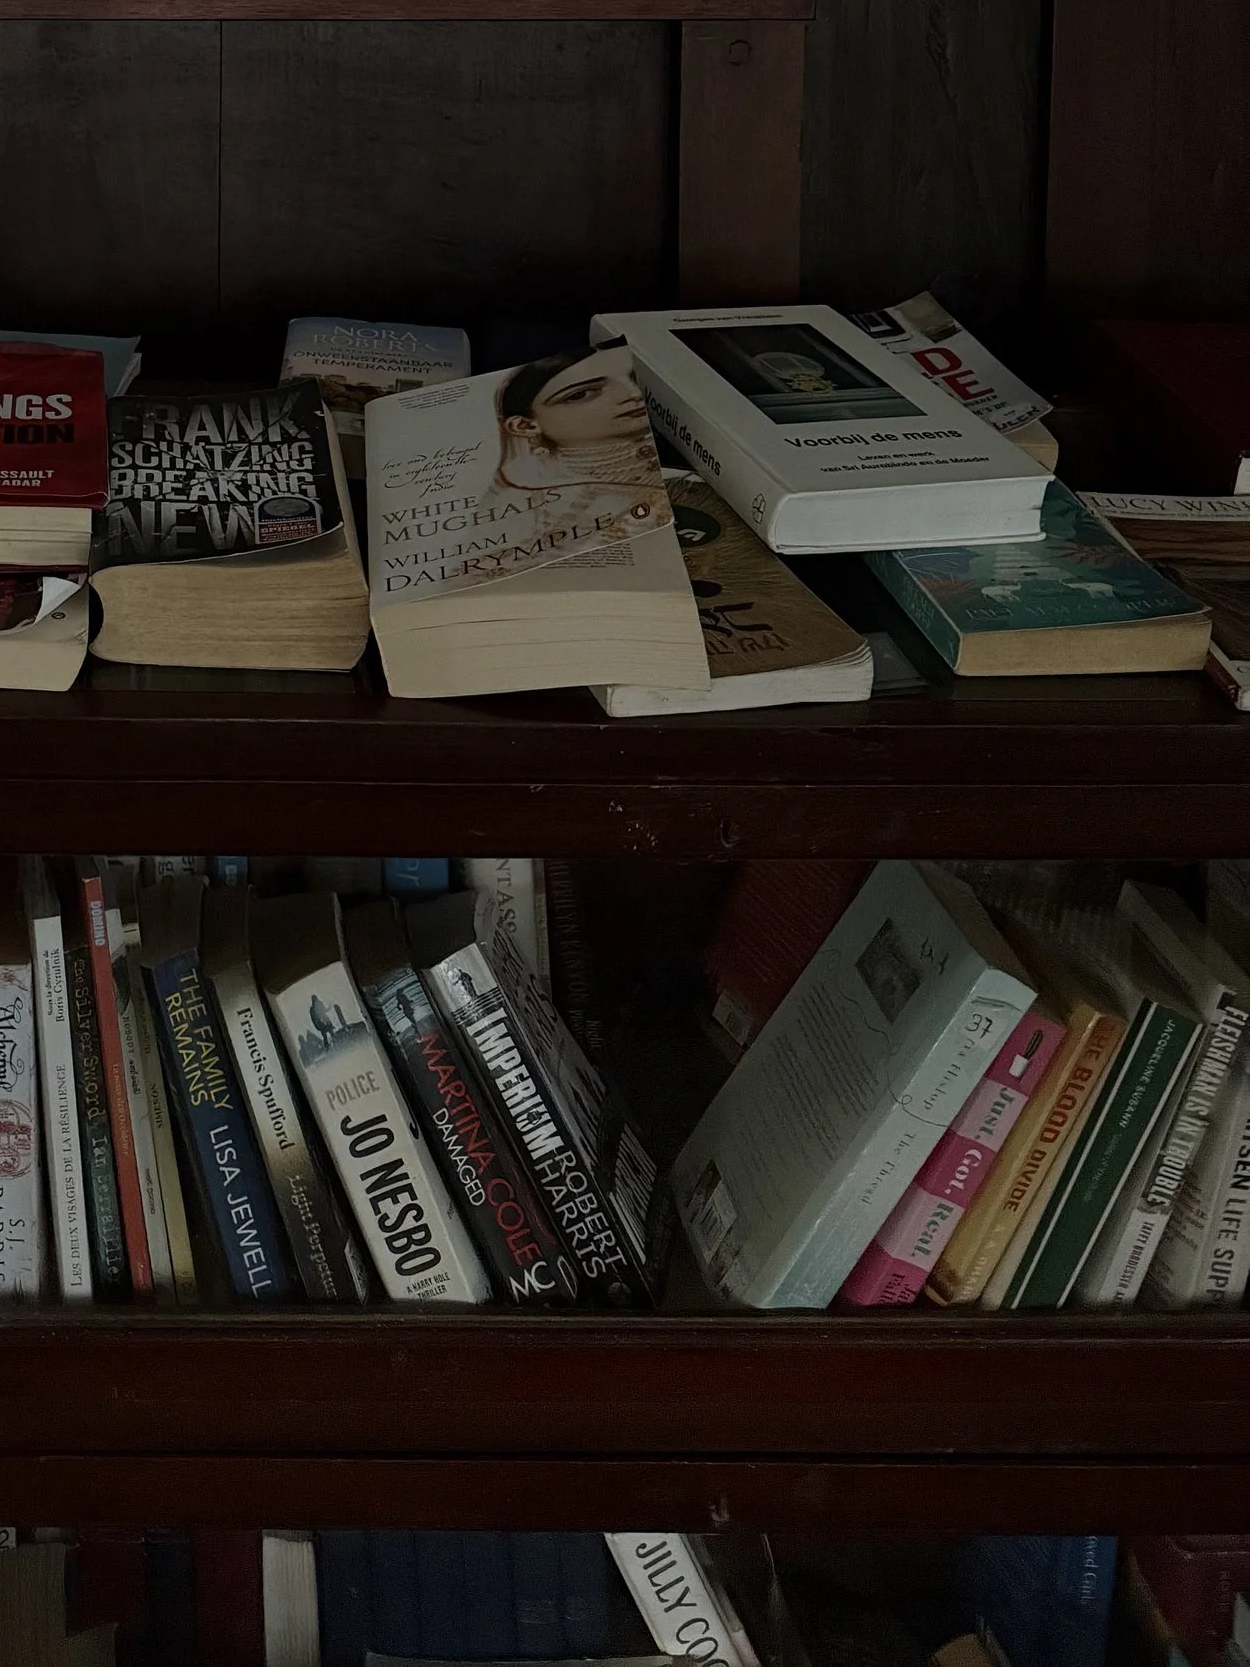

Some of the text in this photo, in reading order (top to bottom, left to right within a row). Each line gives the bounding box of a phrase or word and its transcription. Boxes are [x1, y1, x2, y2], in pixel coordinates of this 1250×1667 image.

[313, 334, 439, 352] ROBERTS
[333, 325, 418, 342] NORA
[314, 358, 433, 374] TEMPERAMENT
[783, 428, 964, 450] Voorbij mens
[109, 468, 318, 502] BREAKING
[382, 496, 480, 525] WHITE
[1090, 496, 1166, 511] LUCY
[383, 488, 562, 546] MUGHALS
[383, 532, 508, 570] WILLIAM
[385, 512, 616, 593] DALRYMPLE
[89, 900, 106, 946] DOMINO
[75, 985, 98, 1052] Silver
[179, 968, 235, 1111] THE FAMILY
[164, 992, 210, 1107] REMAINS
[1134, 1018, 1175, 1085] JACQUELINE
[81, 1054, 107, 1118] Sword
[148, 1082, 165, 1130] SIMENON
[236, 1007, 296, 1151] Francis Spufford
[324, 1070, 382, 1111] POLICE
[466, 1007, 565, 1162] IMPERIUM
[1145, 1006, 1250, 1209] FLEISHMAN TROUBLE
[973, 1086, 1014, 1141] Just.
[1006, 1066, 1094, 1213] BLOOD DIVIDE
[56, 1064, 85, 1288] LES DEUX VISAGES RÉSILIENCE
[91, 1134, 110, 1170] Ian
[416, 1032, 545, 1270] MARTINA COLE
[431, 1107, 488, 1207] DAMAGED
[944, 1147, 983, 1195] Got.
[208, 1123, 273, 1299] LISA JEWELL
[286, 1173, 315, 1221] Light
[340, 1113, 442, 1277] JO NESBO
[533, 1146, 628, 1281] ROBERT HARRIS
[1217, 1197, 1247, 1240] LIFE
[909, 1202, 954, 1258] Real.
[635, 1540, 699, 1614] JILLY
